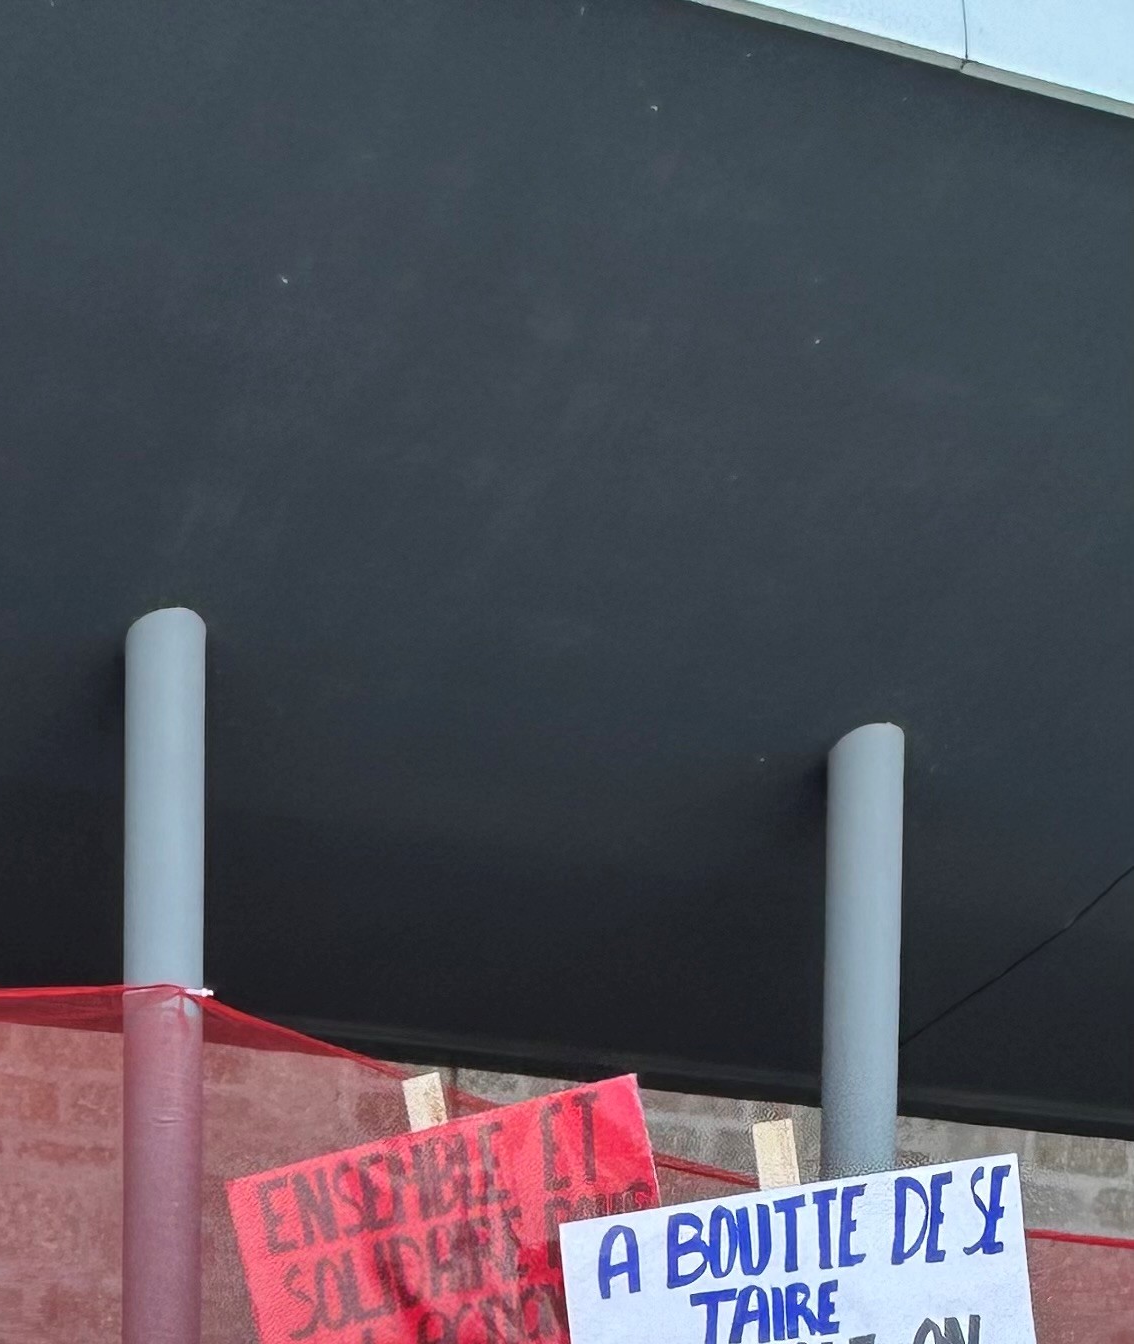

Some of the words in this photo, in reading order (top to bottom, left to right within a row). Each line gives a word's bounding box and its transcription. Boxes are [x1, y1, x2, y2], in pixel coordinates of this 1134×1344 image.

[540, 1092, 598, 1192] ET
[597, 1224, 642, 1300] A
[666, 1182, 868, 1290] BOUTTE
[890, 1171, 953, 1266] DE
[963, 1163, 1012, 1256] SE
